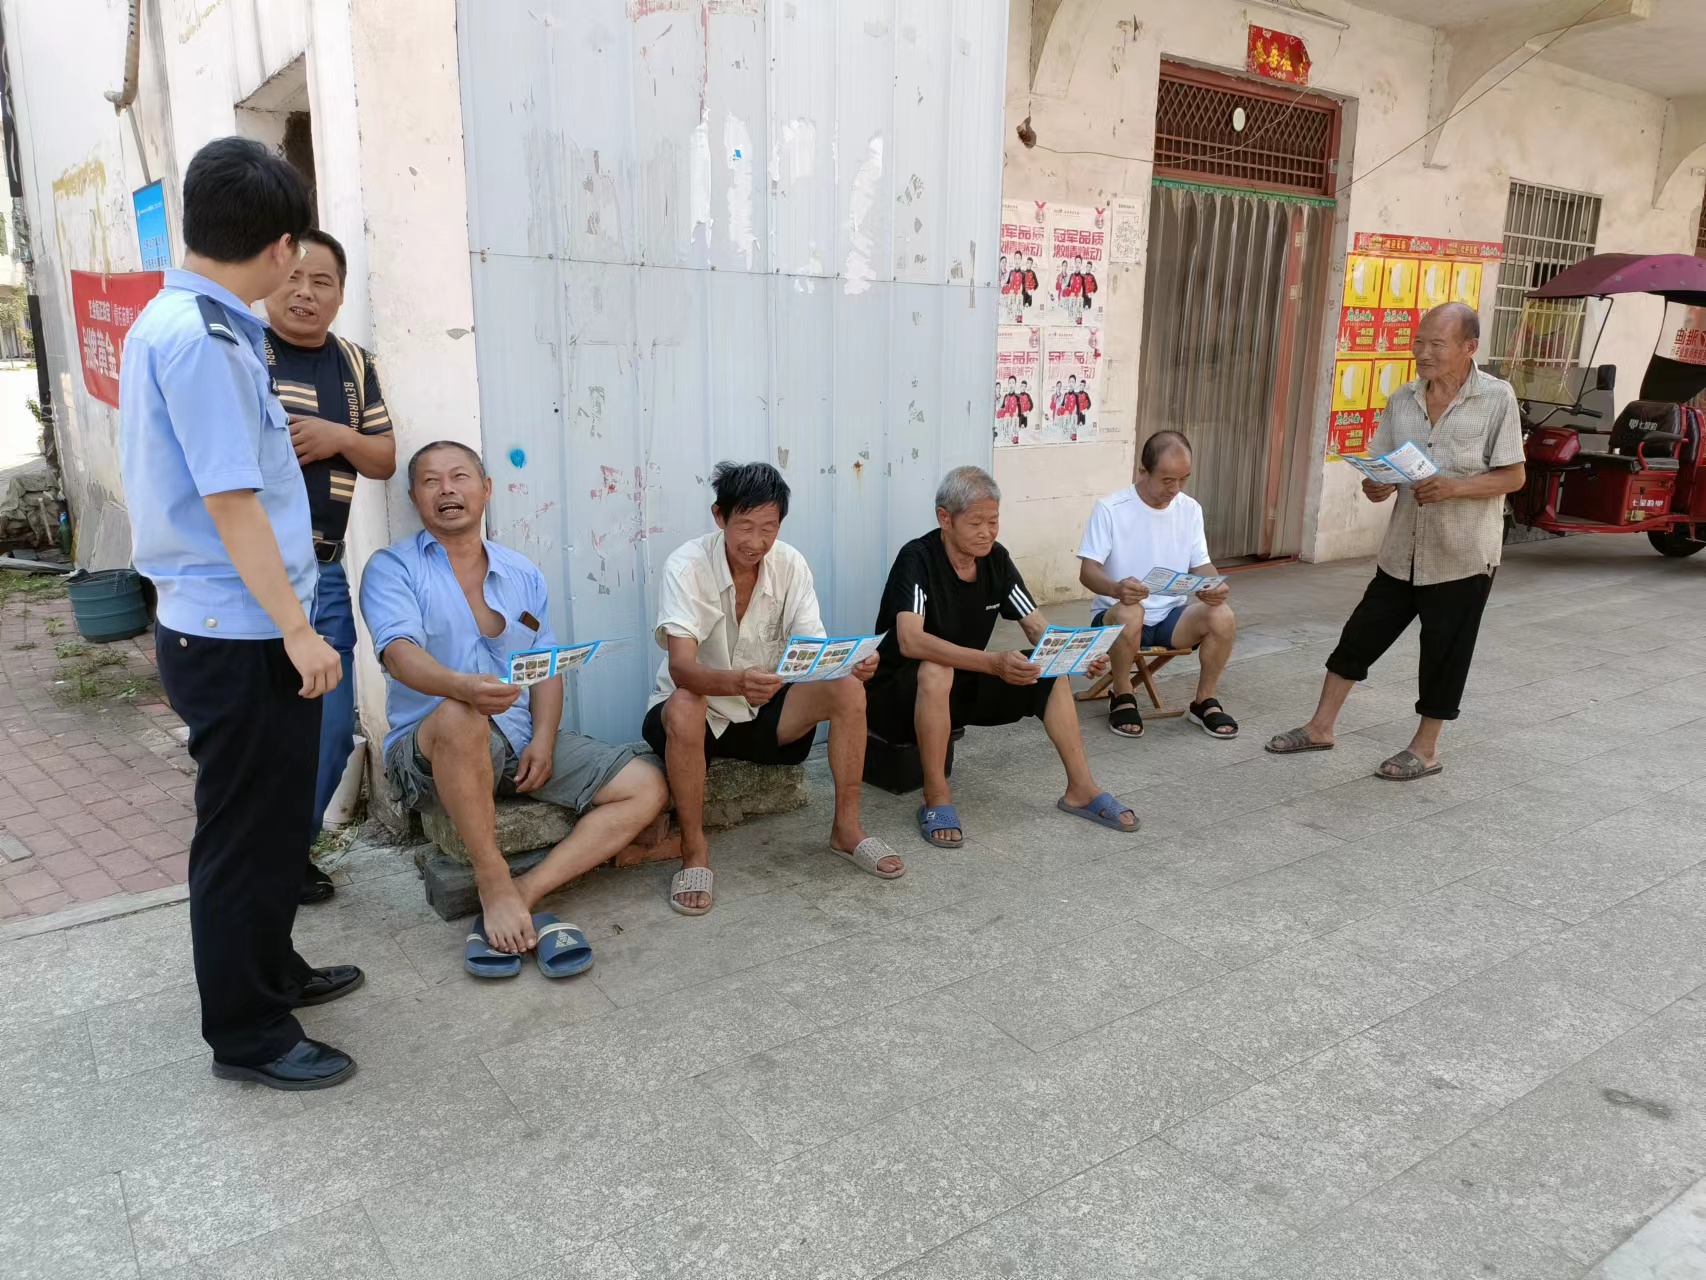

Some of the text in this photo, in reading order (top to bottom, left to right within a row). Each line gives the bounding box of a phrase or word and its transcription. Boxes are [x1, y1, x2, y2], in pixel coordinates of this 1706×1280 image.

[1053, 228, 1105, 246] 冠军品质
[1053, 244, 1102, 261] 激情燃动
[997, 351, 1039, 365] 军品质
[343, 381, 360, 431] BEYORBRH
